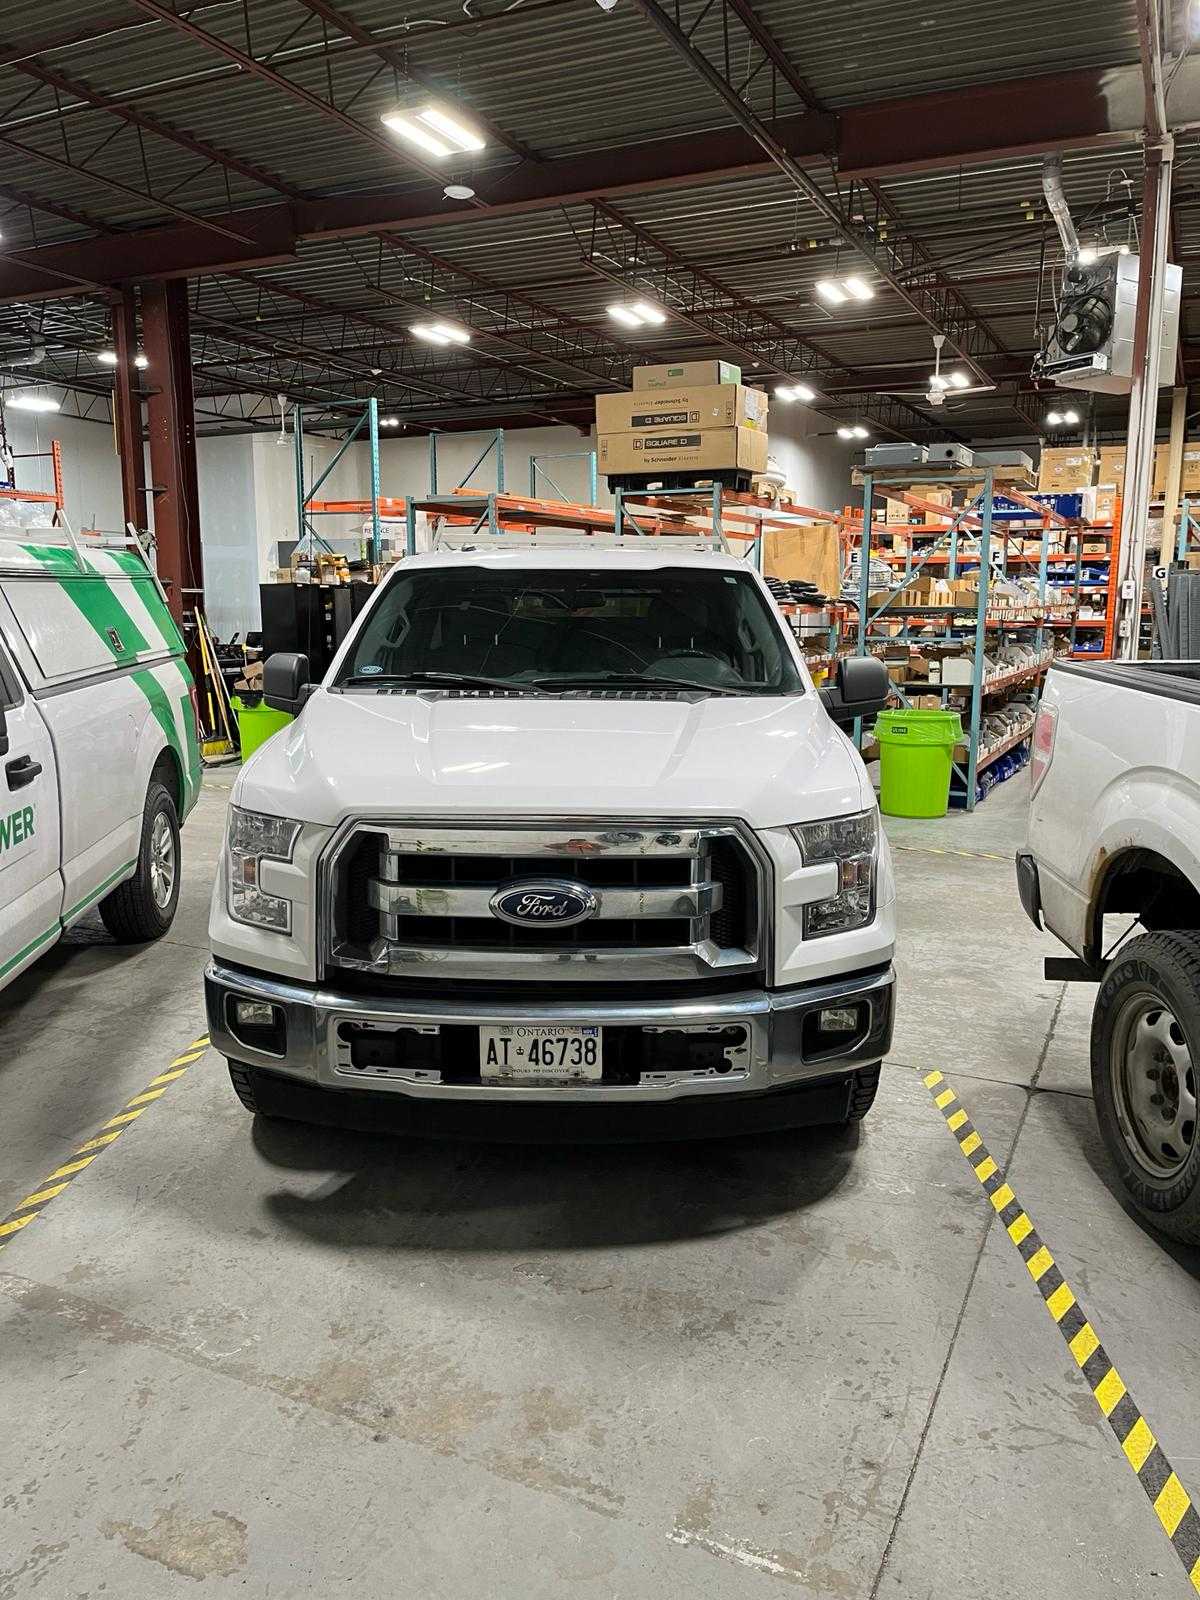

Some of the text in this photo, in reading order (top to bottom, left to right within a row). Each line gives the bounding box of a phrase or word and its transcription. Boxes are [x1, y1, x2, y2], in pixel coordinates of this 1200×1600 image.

[654, 415, 687, 423] SQUARE
[646, 439, 678, 447] SQUARE
[851, 552, 858, 563] E
[992, 551, 1000, 562] F
[1155, 567, 1166, 579] G
[517, 894, 568, 916] Ford
[486, 1038, 597, 1065] AT 46738
